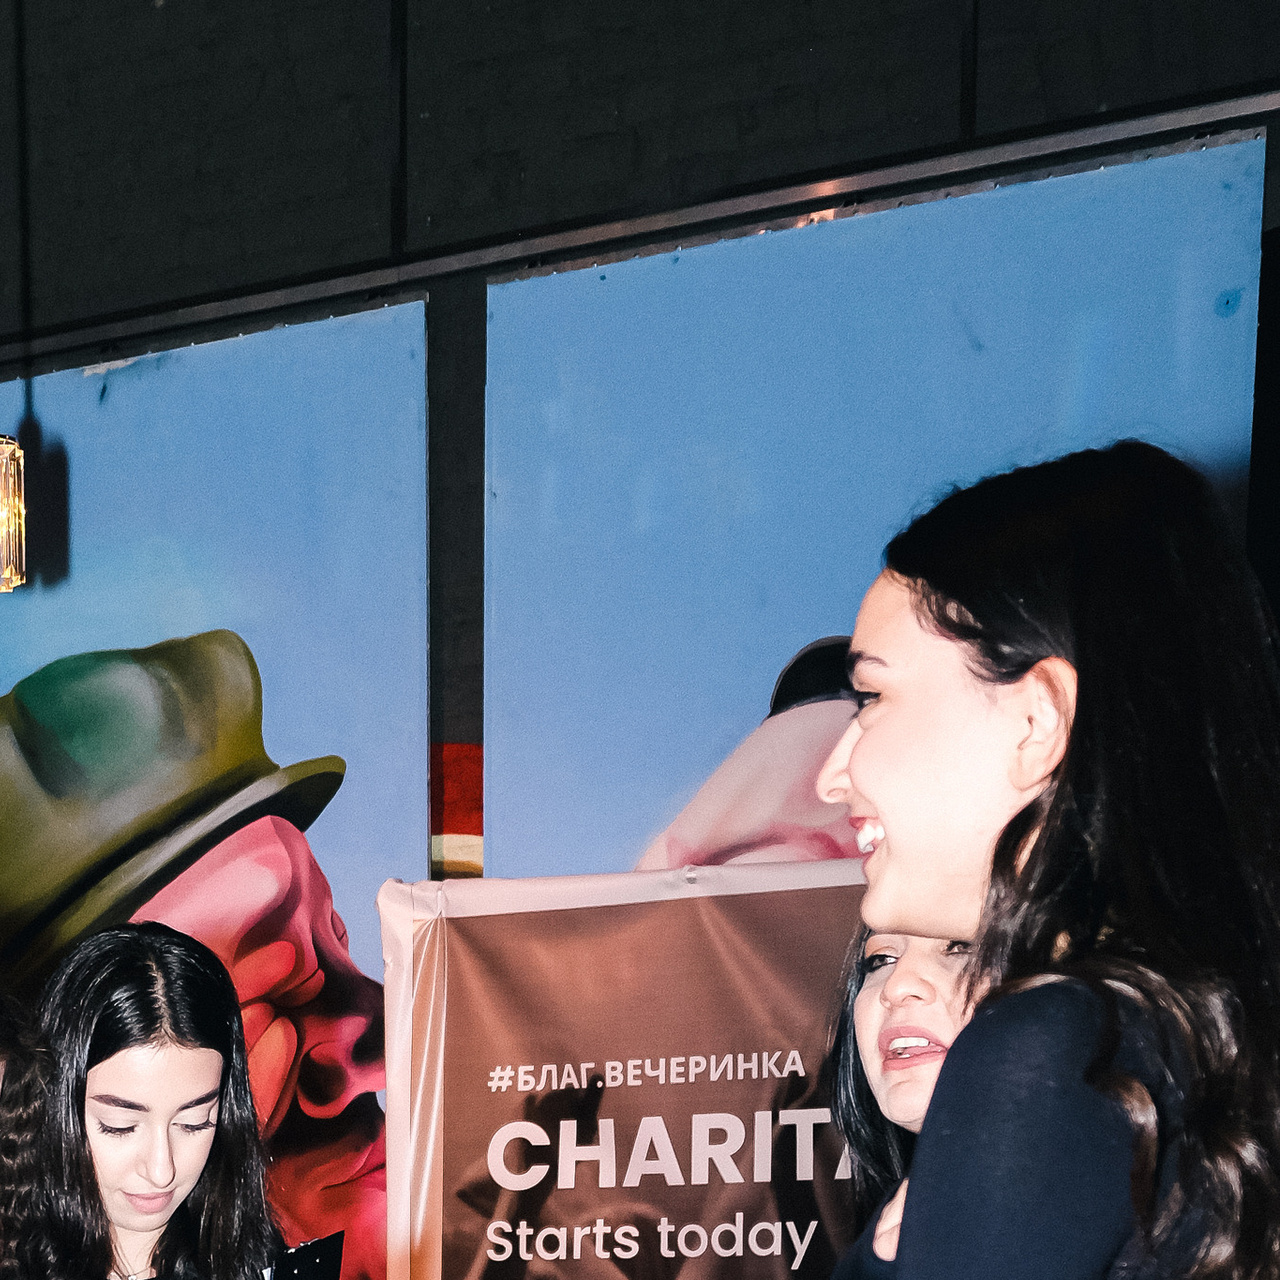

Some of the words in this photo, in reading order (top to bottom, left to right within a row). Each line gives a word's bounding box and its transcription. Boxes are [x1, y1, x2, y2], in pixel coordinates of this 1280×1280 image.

[487, 1050, 806, 1093] #БЛАГ.ВЕЧЕРИНКА
[486, 1218, 640, 1262] Starts
[657, 1212, 819, 1270] today
